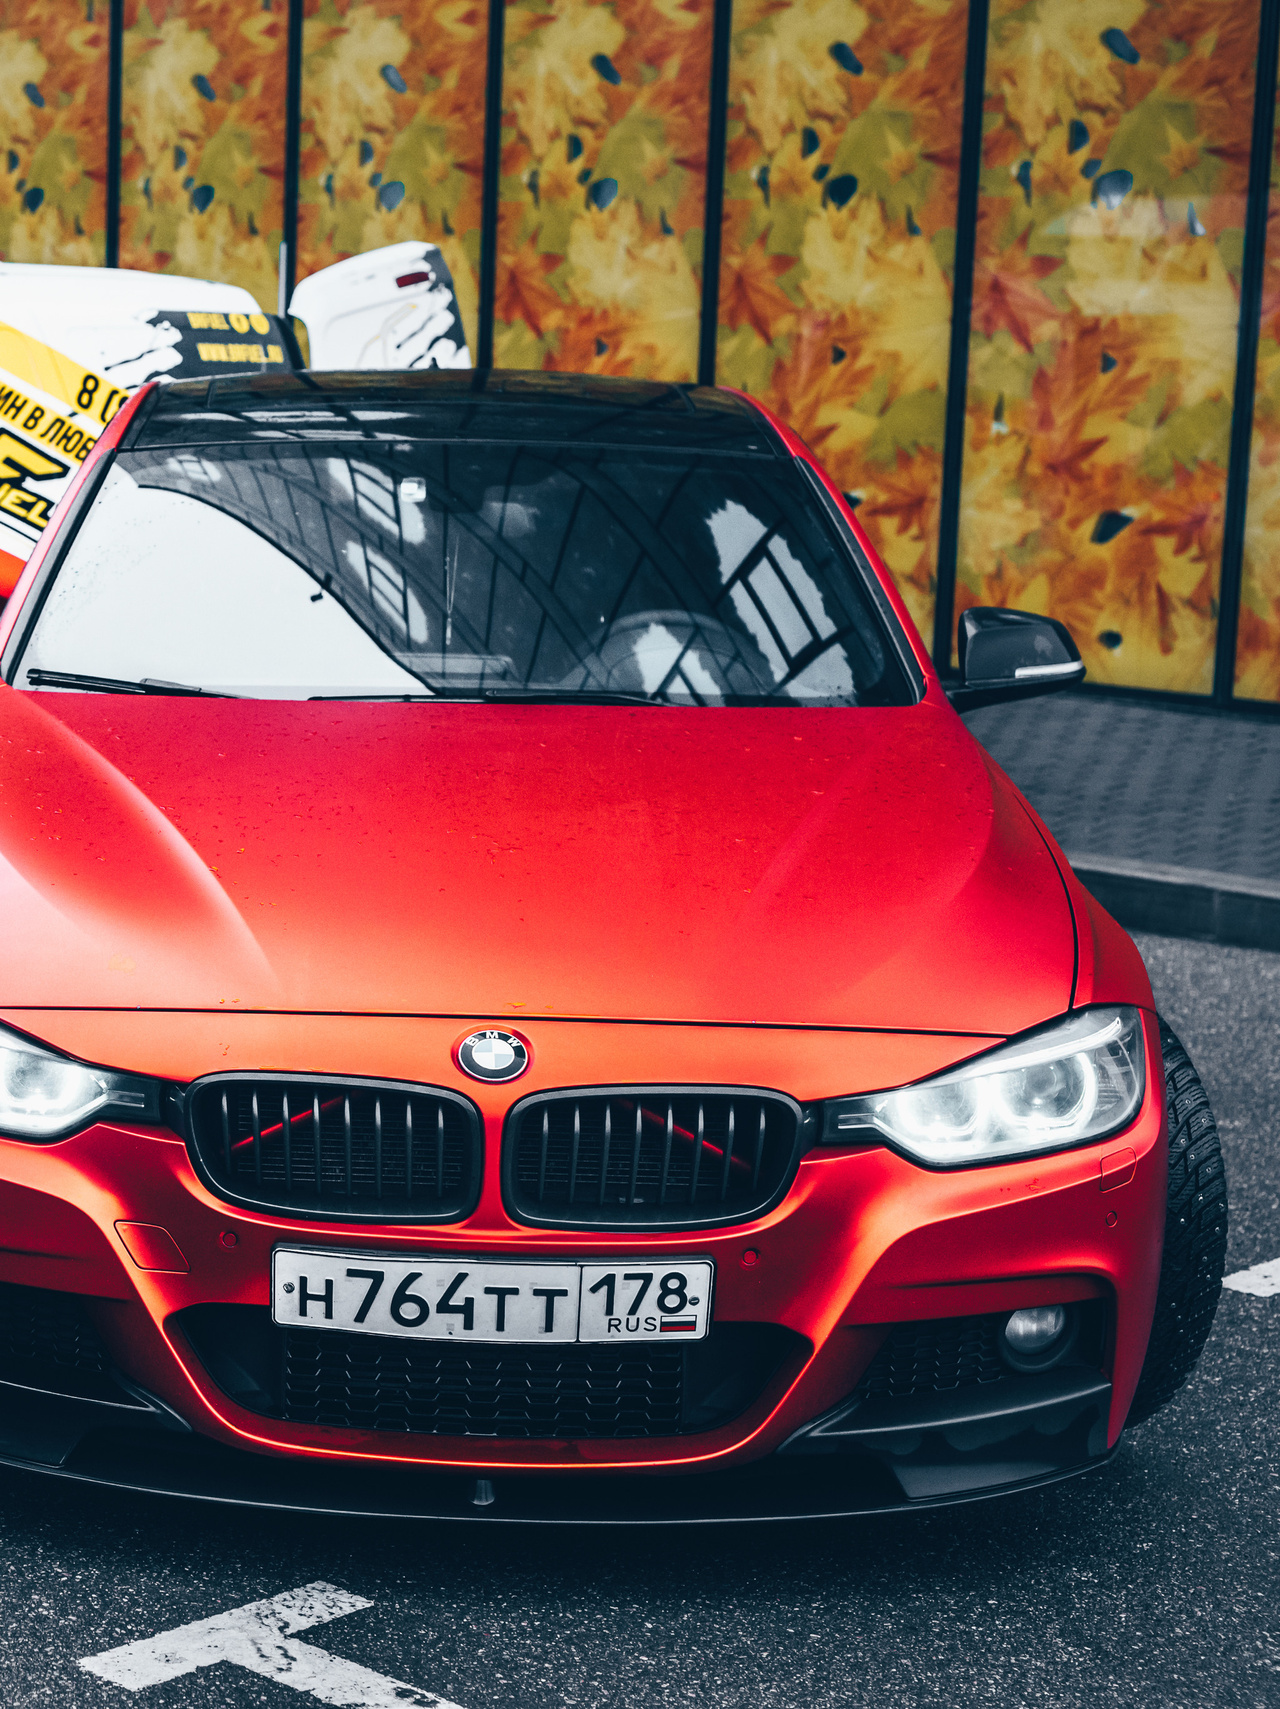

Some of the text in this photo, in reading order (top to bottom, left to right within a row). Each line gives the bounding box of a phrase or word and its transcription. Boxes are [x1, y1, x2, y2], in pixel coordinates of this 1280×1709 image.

[76, 374, 100, 410] 8
[23, 406, 46, 430] В
[465, 1030, 521, 1047] BMW
[588, 1271, 688, 1316] 178
[607, 1317, 657, 1333] RUS
